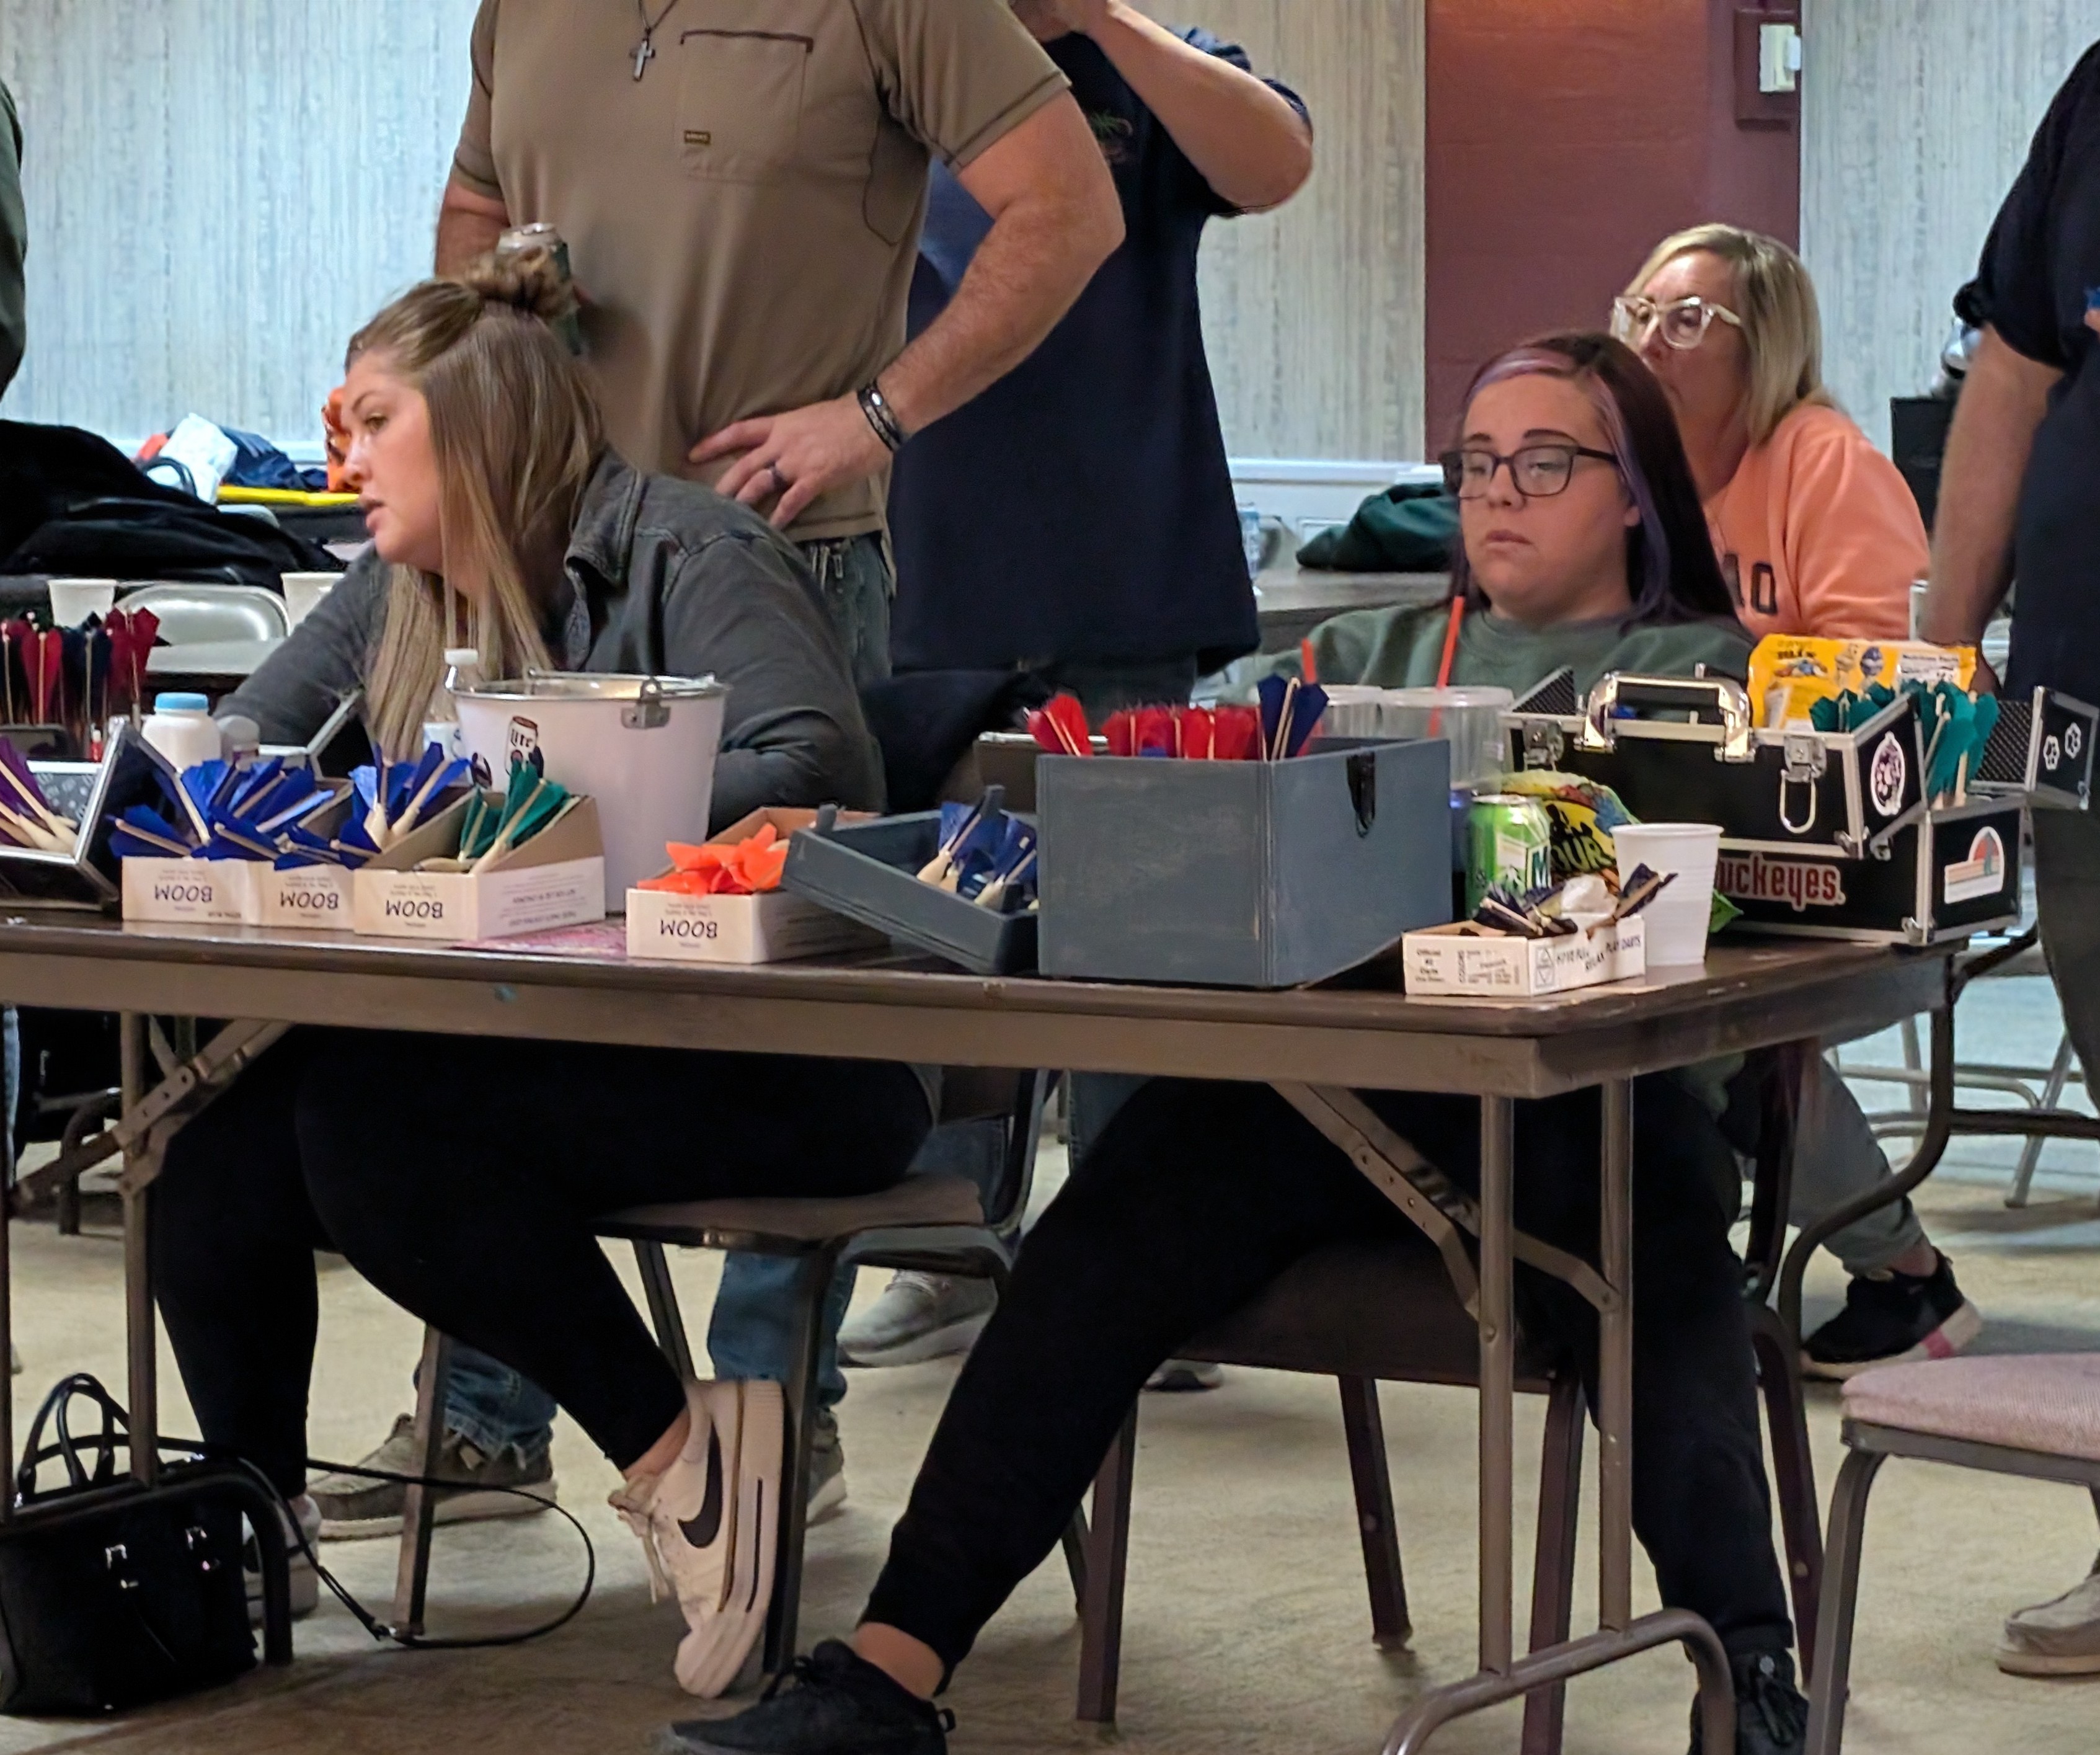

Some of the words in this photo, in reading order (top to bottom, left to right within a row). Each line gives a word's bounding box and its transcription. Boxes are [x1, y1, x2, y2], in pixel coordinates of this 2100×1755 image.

[1550, 835, 1617, 872] OUR
[1715, 855, 1836, 907] uckeyes
[154, 885, 213, 904] BOOM
[280, 891, 339, 910] BOOM
[386, 899, 444, 920] BOOM
[660, 918, 718, 940] BOOM
